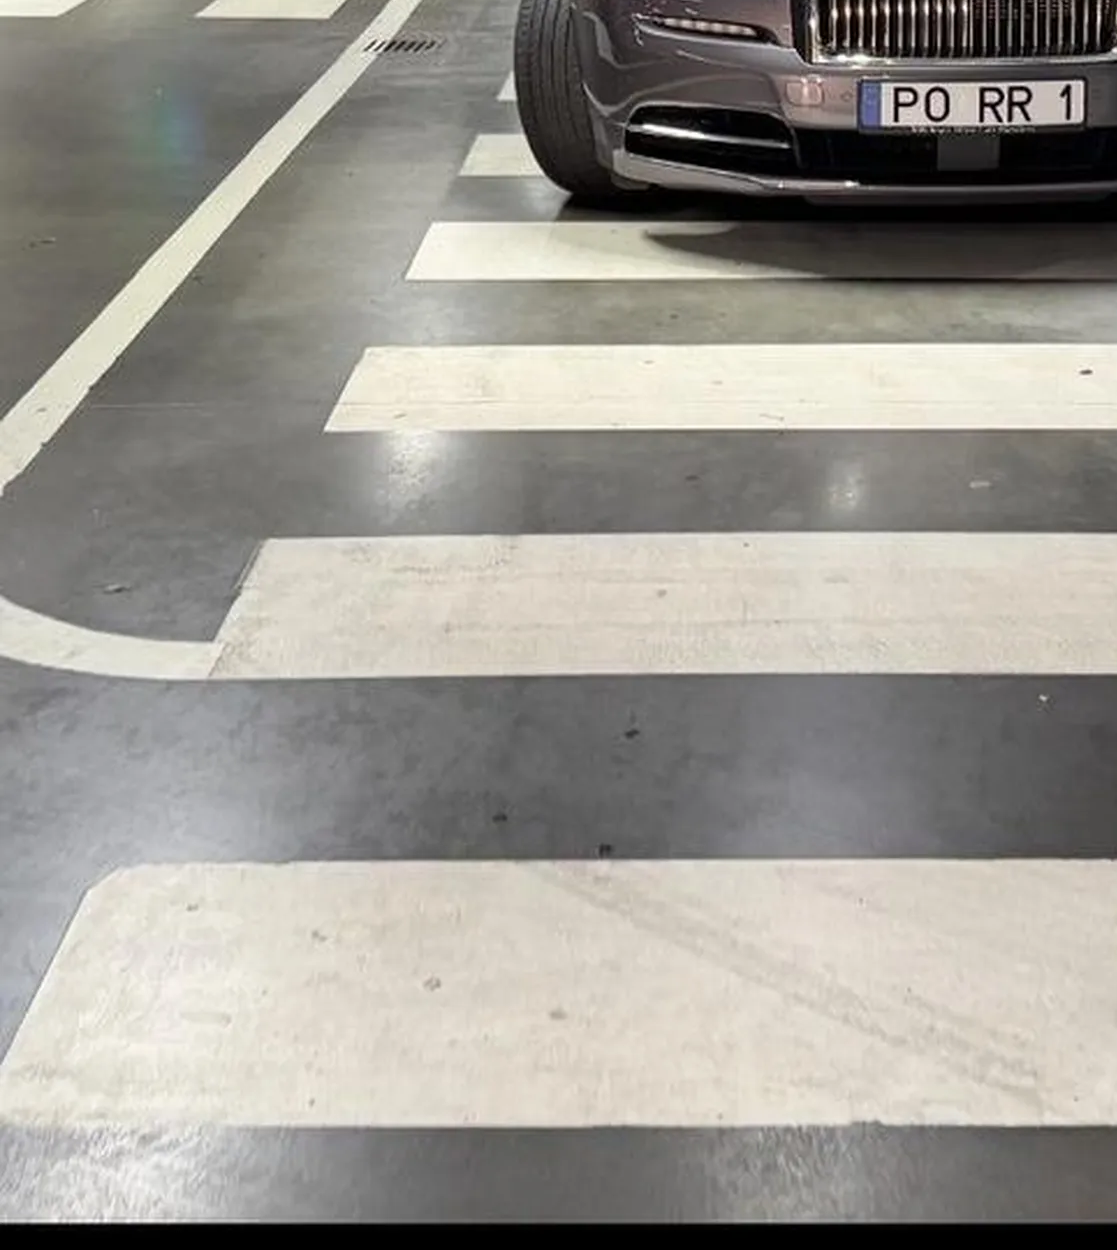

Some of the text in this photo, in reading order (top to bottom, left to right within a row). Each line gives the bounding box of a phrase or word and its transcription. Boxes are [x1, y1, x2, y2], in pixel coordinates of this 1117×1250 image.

[892, 84, 1072, 123] PO RR 1
